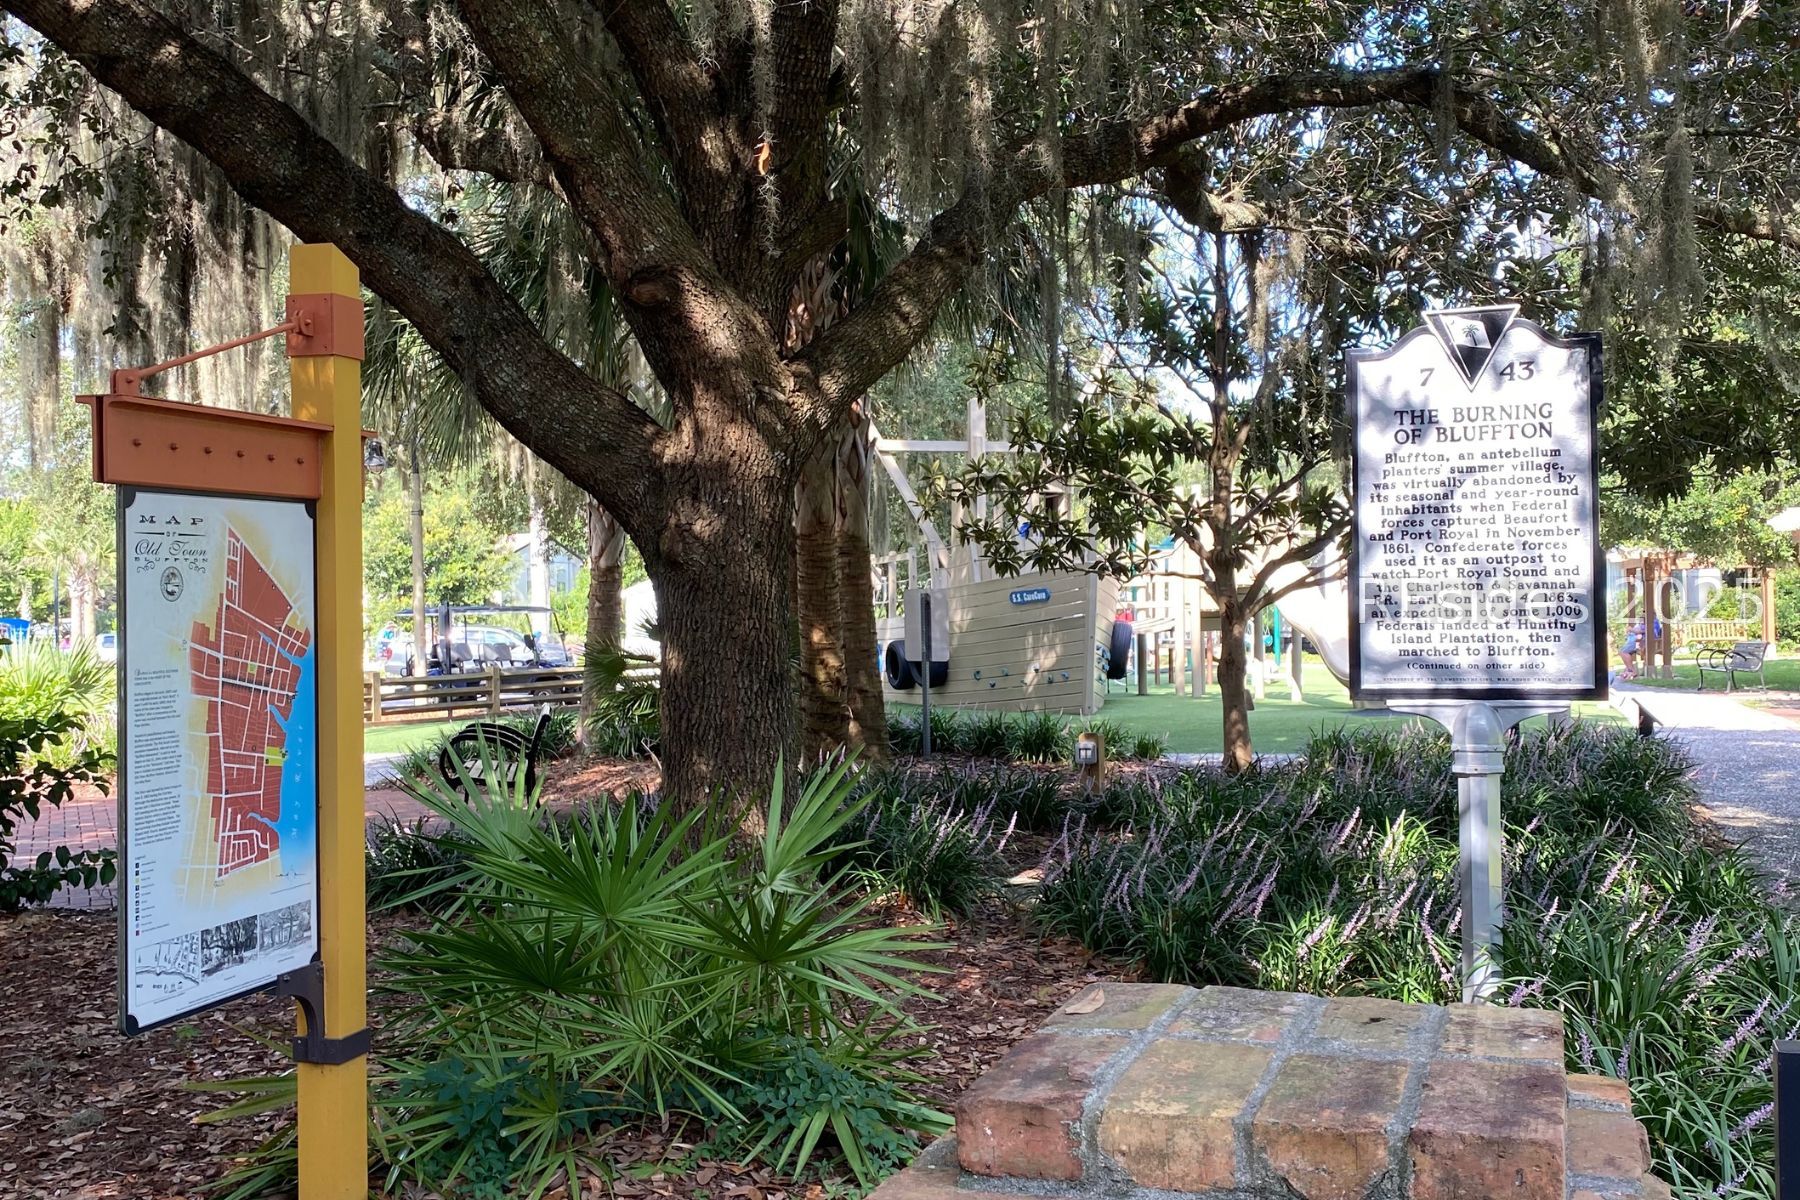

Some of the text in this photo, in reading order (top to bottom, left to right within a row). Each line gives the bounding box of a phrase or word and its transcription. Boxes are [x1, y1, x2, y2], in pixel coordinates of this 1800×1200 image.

[1420, 360, 1535, 387] 7 43
[1394, 402, 1553, 426] THE BURNING
[1394, 422, 1553, 445] OF BLUFFTON
[1385, 447, 1562, 464] Bluffton, an antebellum
[1382, 464, 1443, 479] planters'
[1449, 463, 1504, 474] summer
[1372, 472, 1577, 491] was virtually abandoned by
[1369, 485, 1579, 504] its seasonal and year-round
[1381, 499, 1568, 516] inhabitants when Federal
[139, 514, 204, 526] MAP
[1381, 512, 1568, 529] forces captured Beaufort
[1369, 525, 1581, 542] and Port Royal in November
[135, 538, 207, 556] Old Town
[1383, 540, 1568, 554] 1861. Confederate forces
[1384, 552, 1567, 567] used it as an outpost to
[1372, 565, 1580, 580] watch Port Royal Sound and
[1376, 578, 1576, 593] the Charleston & Savannah
[1409, 593, 1447, 606] Early
[1454, 595, 1472, 604] on
[1478, 592, 1512, 604] June
[1371, 609, 1388, 618] an
[1393, 607, 1473, 620] expedition
[1502, 608, 1540, 617] some
[1376, 618, 1577, 632] Federals landed at Hunting
[1391, 631, 1562, 644] Island Plantation, then
[1398, 644, 1556, 658] marched to Bluffton.
[1407, 661, 1462, 671] (Continued
[1485, 661, 1513, 670] other
[1519, 661, 1546, 671] side)
